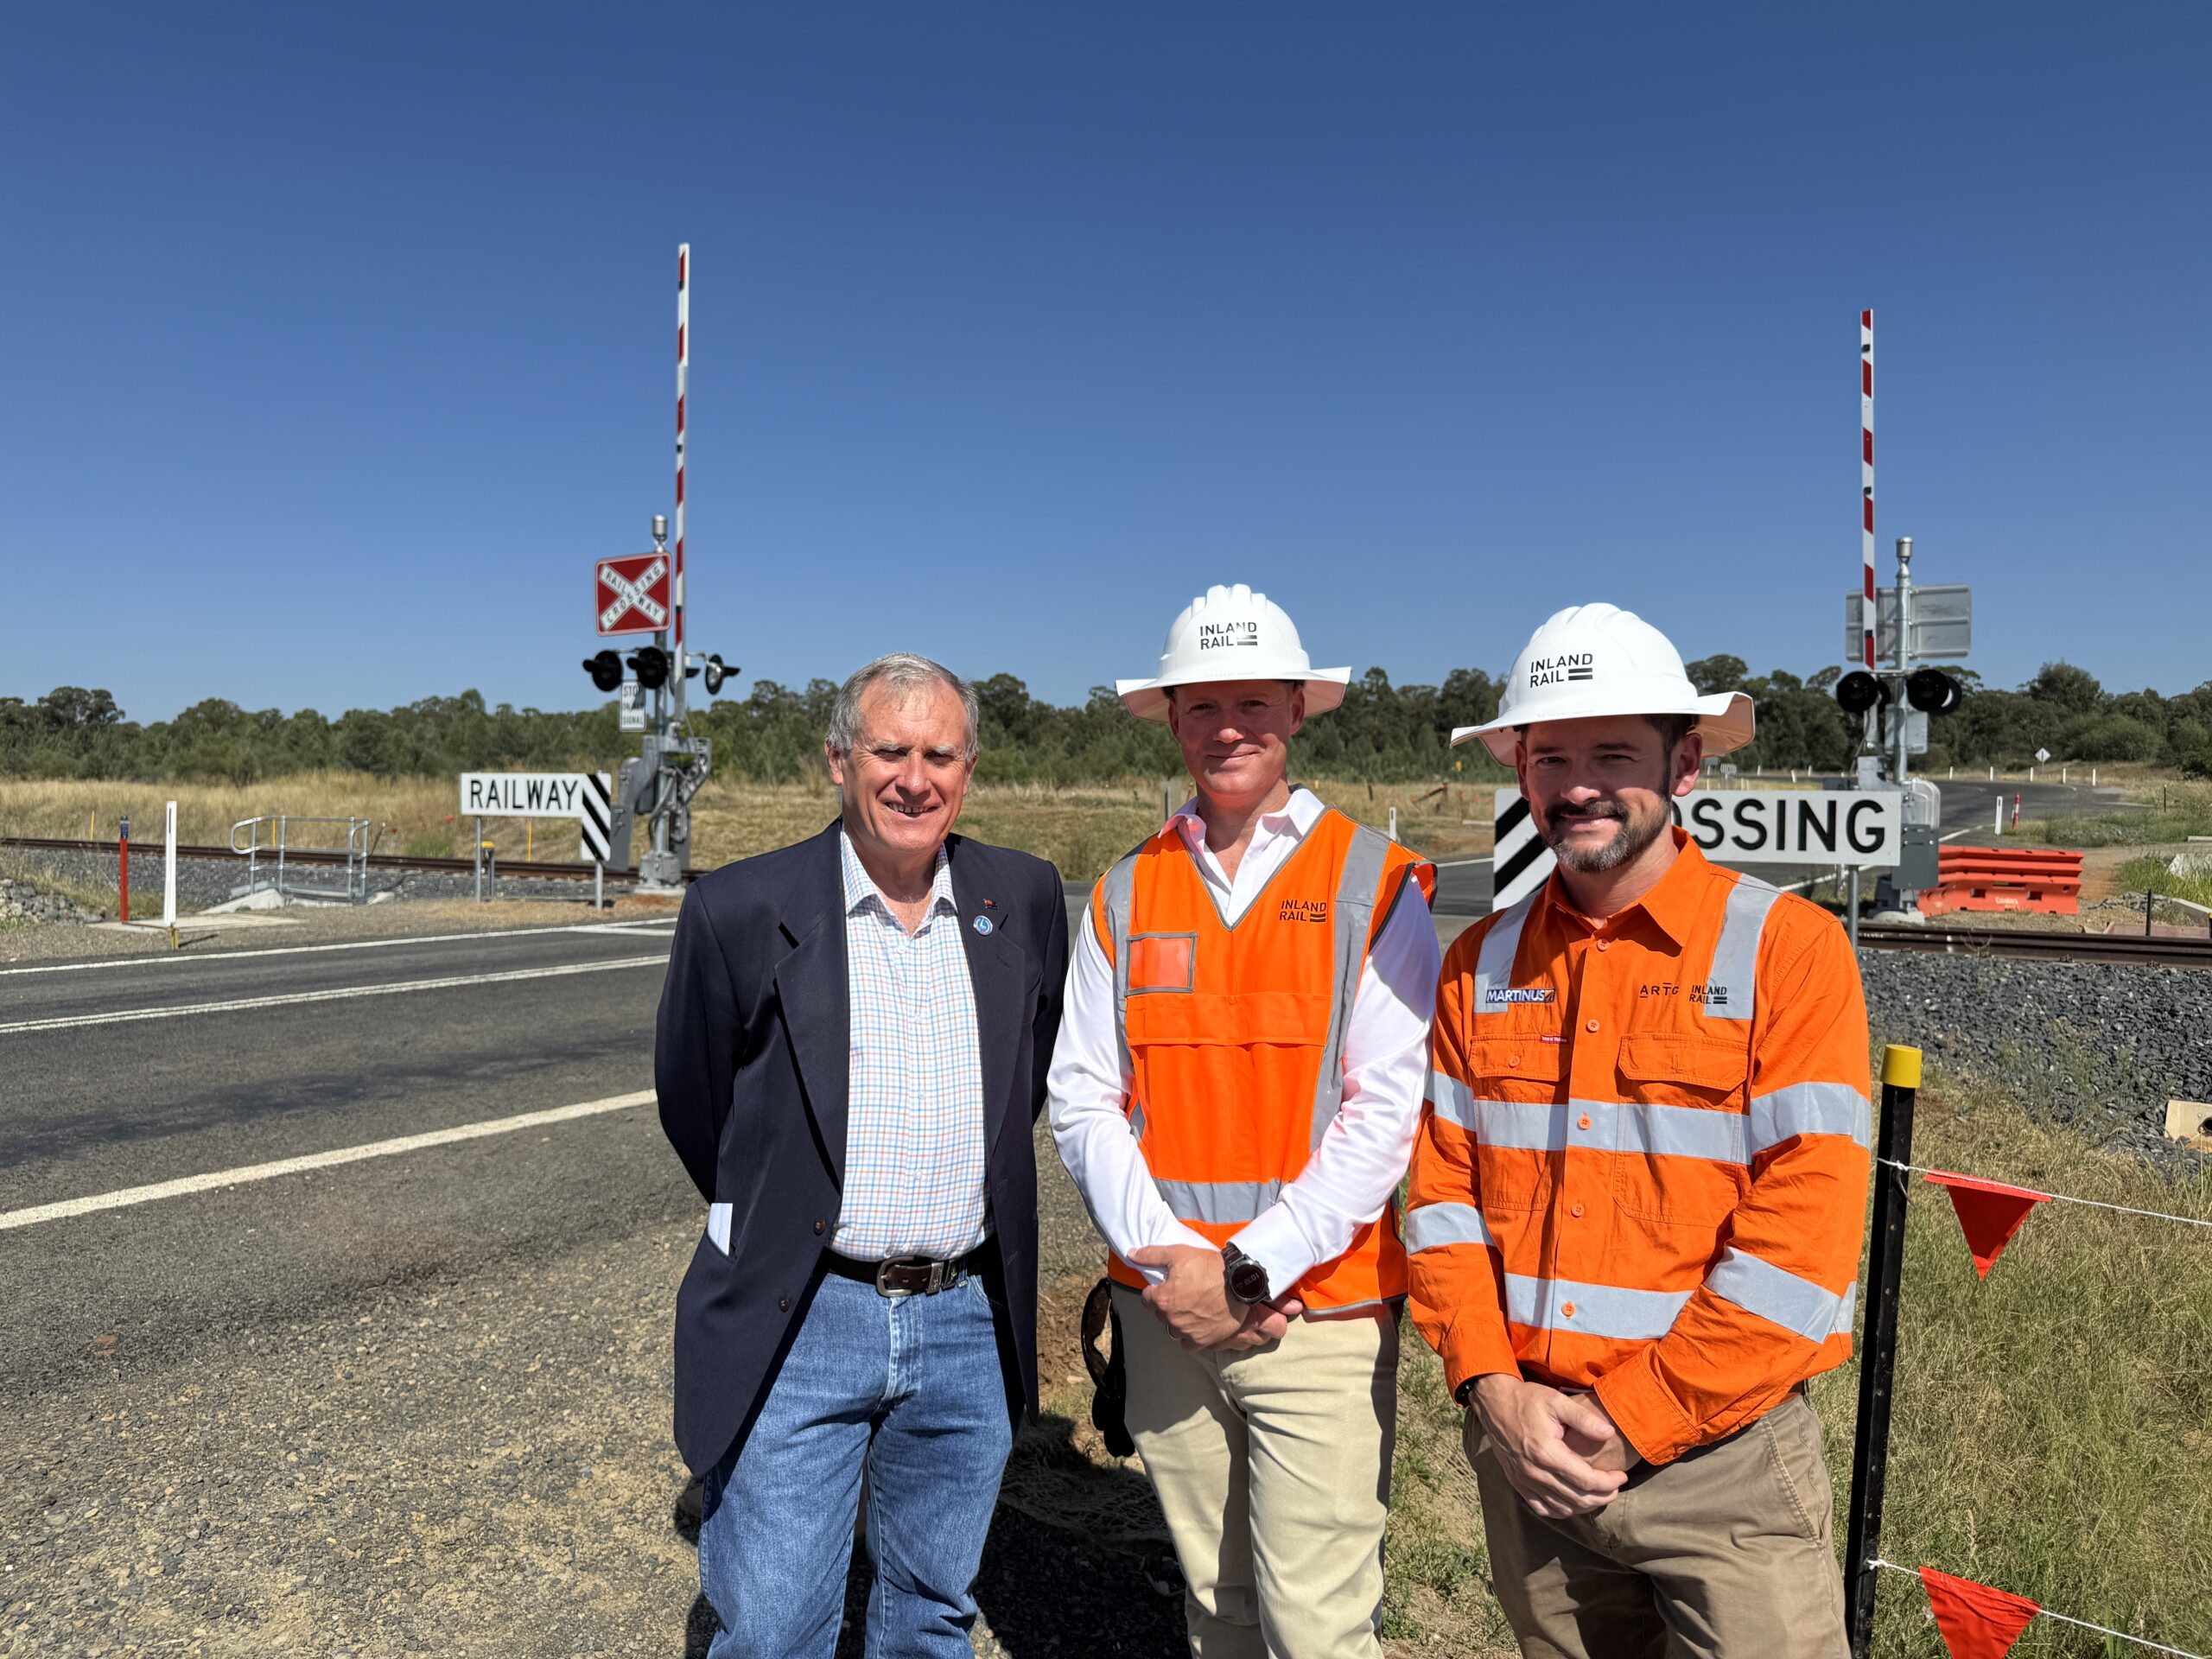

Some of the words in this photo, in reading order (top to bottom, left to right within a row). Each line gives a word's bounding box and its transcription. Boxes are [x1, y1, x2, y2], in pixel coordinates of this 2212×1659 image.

[606, 570, 660, 618] RAILWAY
[606, 566, 661, 624] CROSSING
[1199, 622, 1257, 637] INLAND
[1200, 635, 1235, 651] RAIL
[1530, 653, 1593, 673] INLAND
[1529, 670, 1565, 689] RAIL
[623, 684, 644, 697] STOP
[470, 779, 578, 810] RAILWAY
[1672, 798, 1885, 854] SSING
[1281, 899, 1327, 912] INLAND
[1279, 911, 1307, 922] RAIL
[1487, 989, 1545, 1001] MARTINUS
[1692, 985, 1727, 995] INLAND
[1689, 994, 1712, 1005] RAIL
